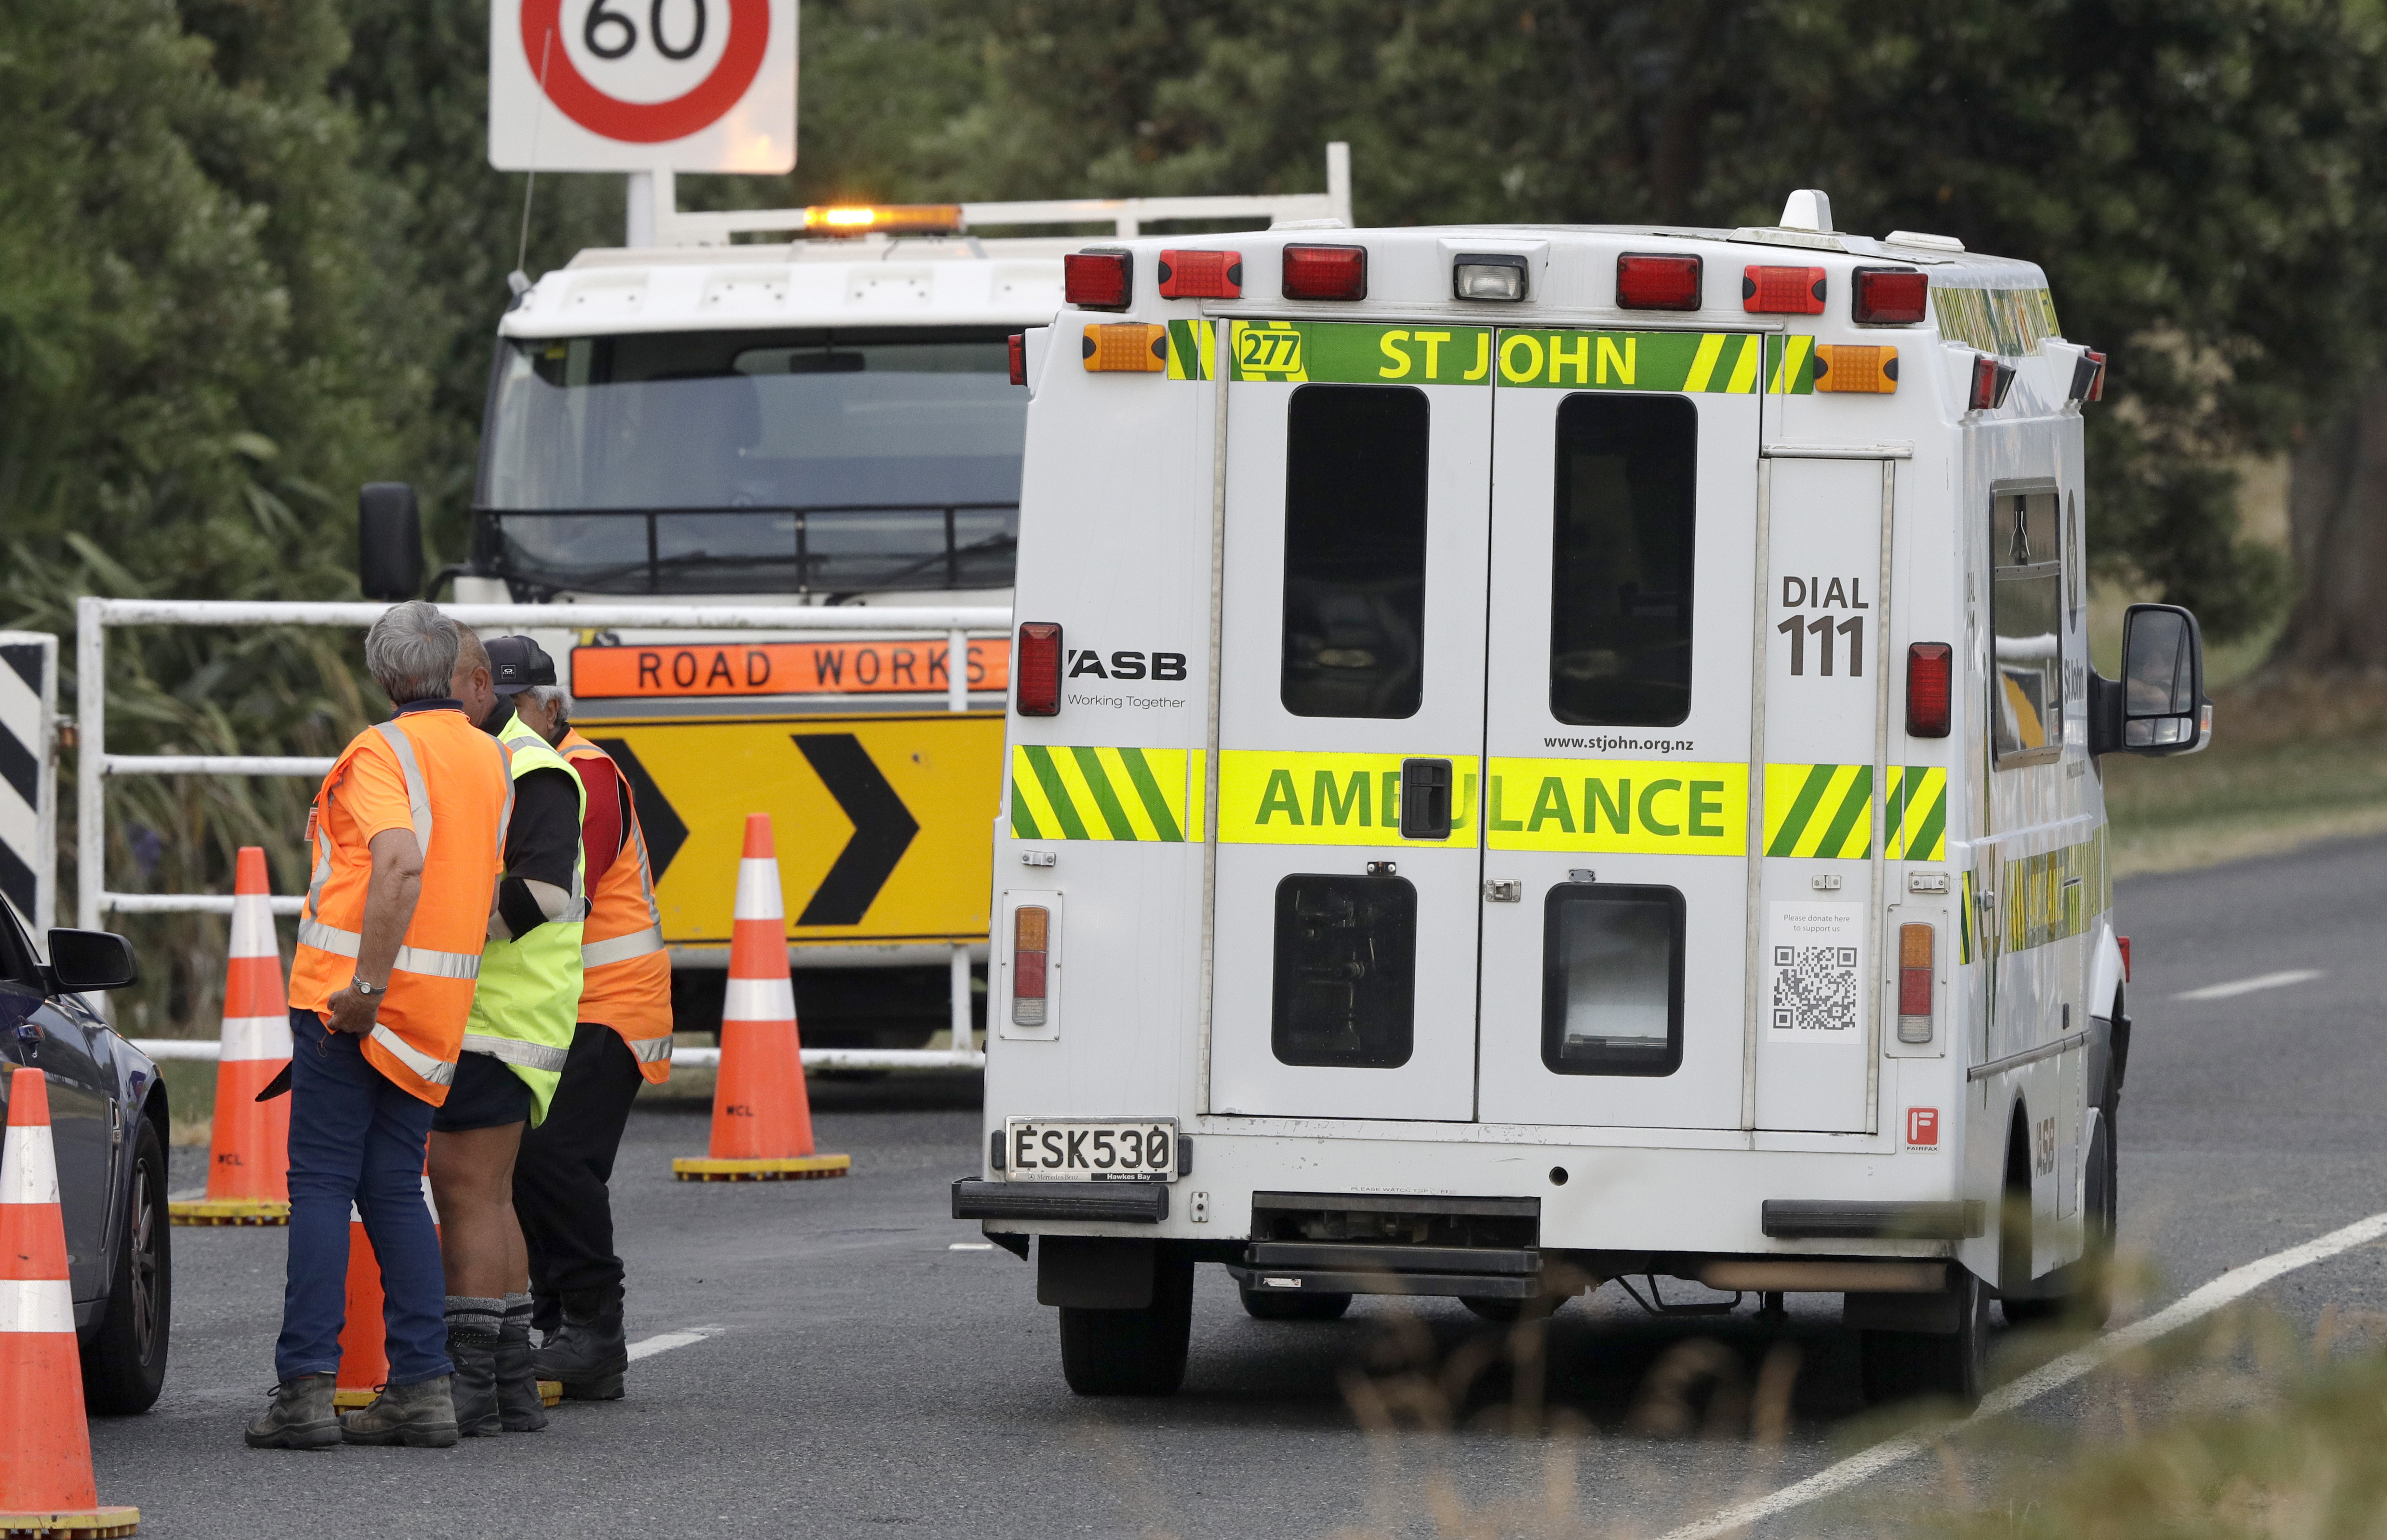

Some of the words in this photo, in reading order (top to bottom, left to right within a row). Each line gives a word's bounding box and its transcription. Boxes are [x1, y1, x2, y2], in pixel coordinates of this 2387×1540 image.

[584, 0, 706, 60] 60
[1243, 334, 1298, 366] 277
[1378, 330, 1451, 379] ST
[1463, 332, 1637, 385] JOHN
[1783, 576, 1869, 609] DIAL
[1068, 649, 1187, 681] ASB
[1777, 615, 1863, 677] 111
[638, 651, 771, 688] ROAD
[813, 648, 986, 685] WORKS
[1068, 694, 1122, 709] Working
[1126, 695, 1186, 710] Together
[1544, 735, 1694, 754] www.stjohn.org.nz
[1016, 1129, 1169, 1168] ESK530
[2036, 1117, 2055, 1179] ASB
